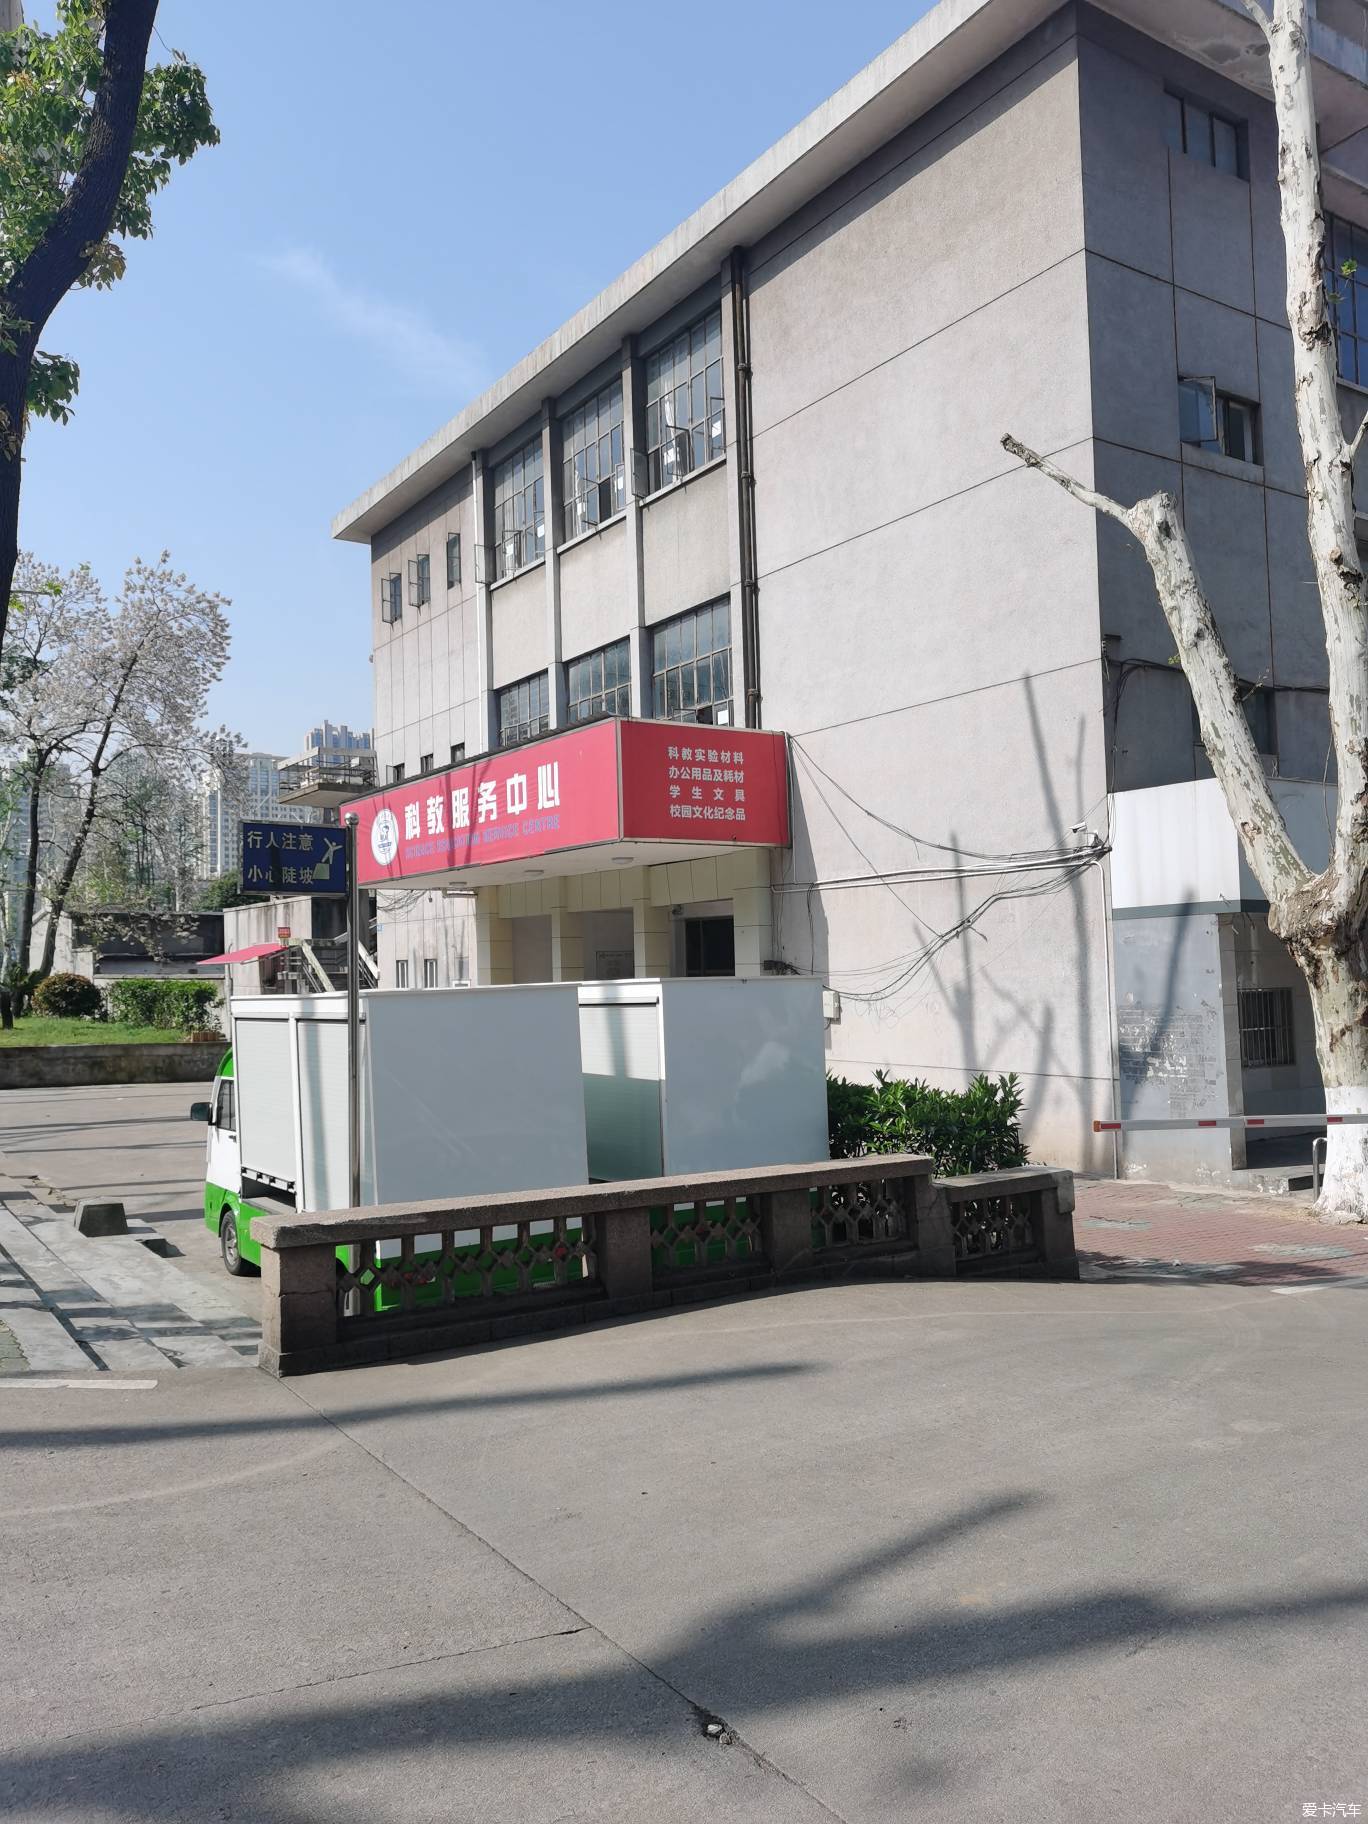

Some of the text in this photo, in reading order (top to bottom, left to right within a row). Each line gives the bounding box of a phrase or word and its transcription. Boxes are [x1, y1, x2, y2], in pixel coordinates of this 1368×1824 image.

[668, 746, 744, 764] 科教实验材料
[668, 765, 744, 783] 办公用品及耗材
[404, 761, 560, 840] 科教服务中心
[669, 785, 745, 802] 学生文具
[669, 804, 746, 821] 校园文化纪念品
[247, 831, 314, 852] 行人注意
